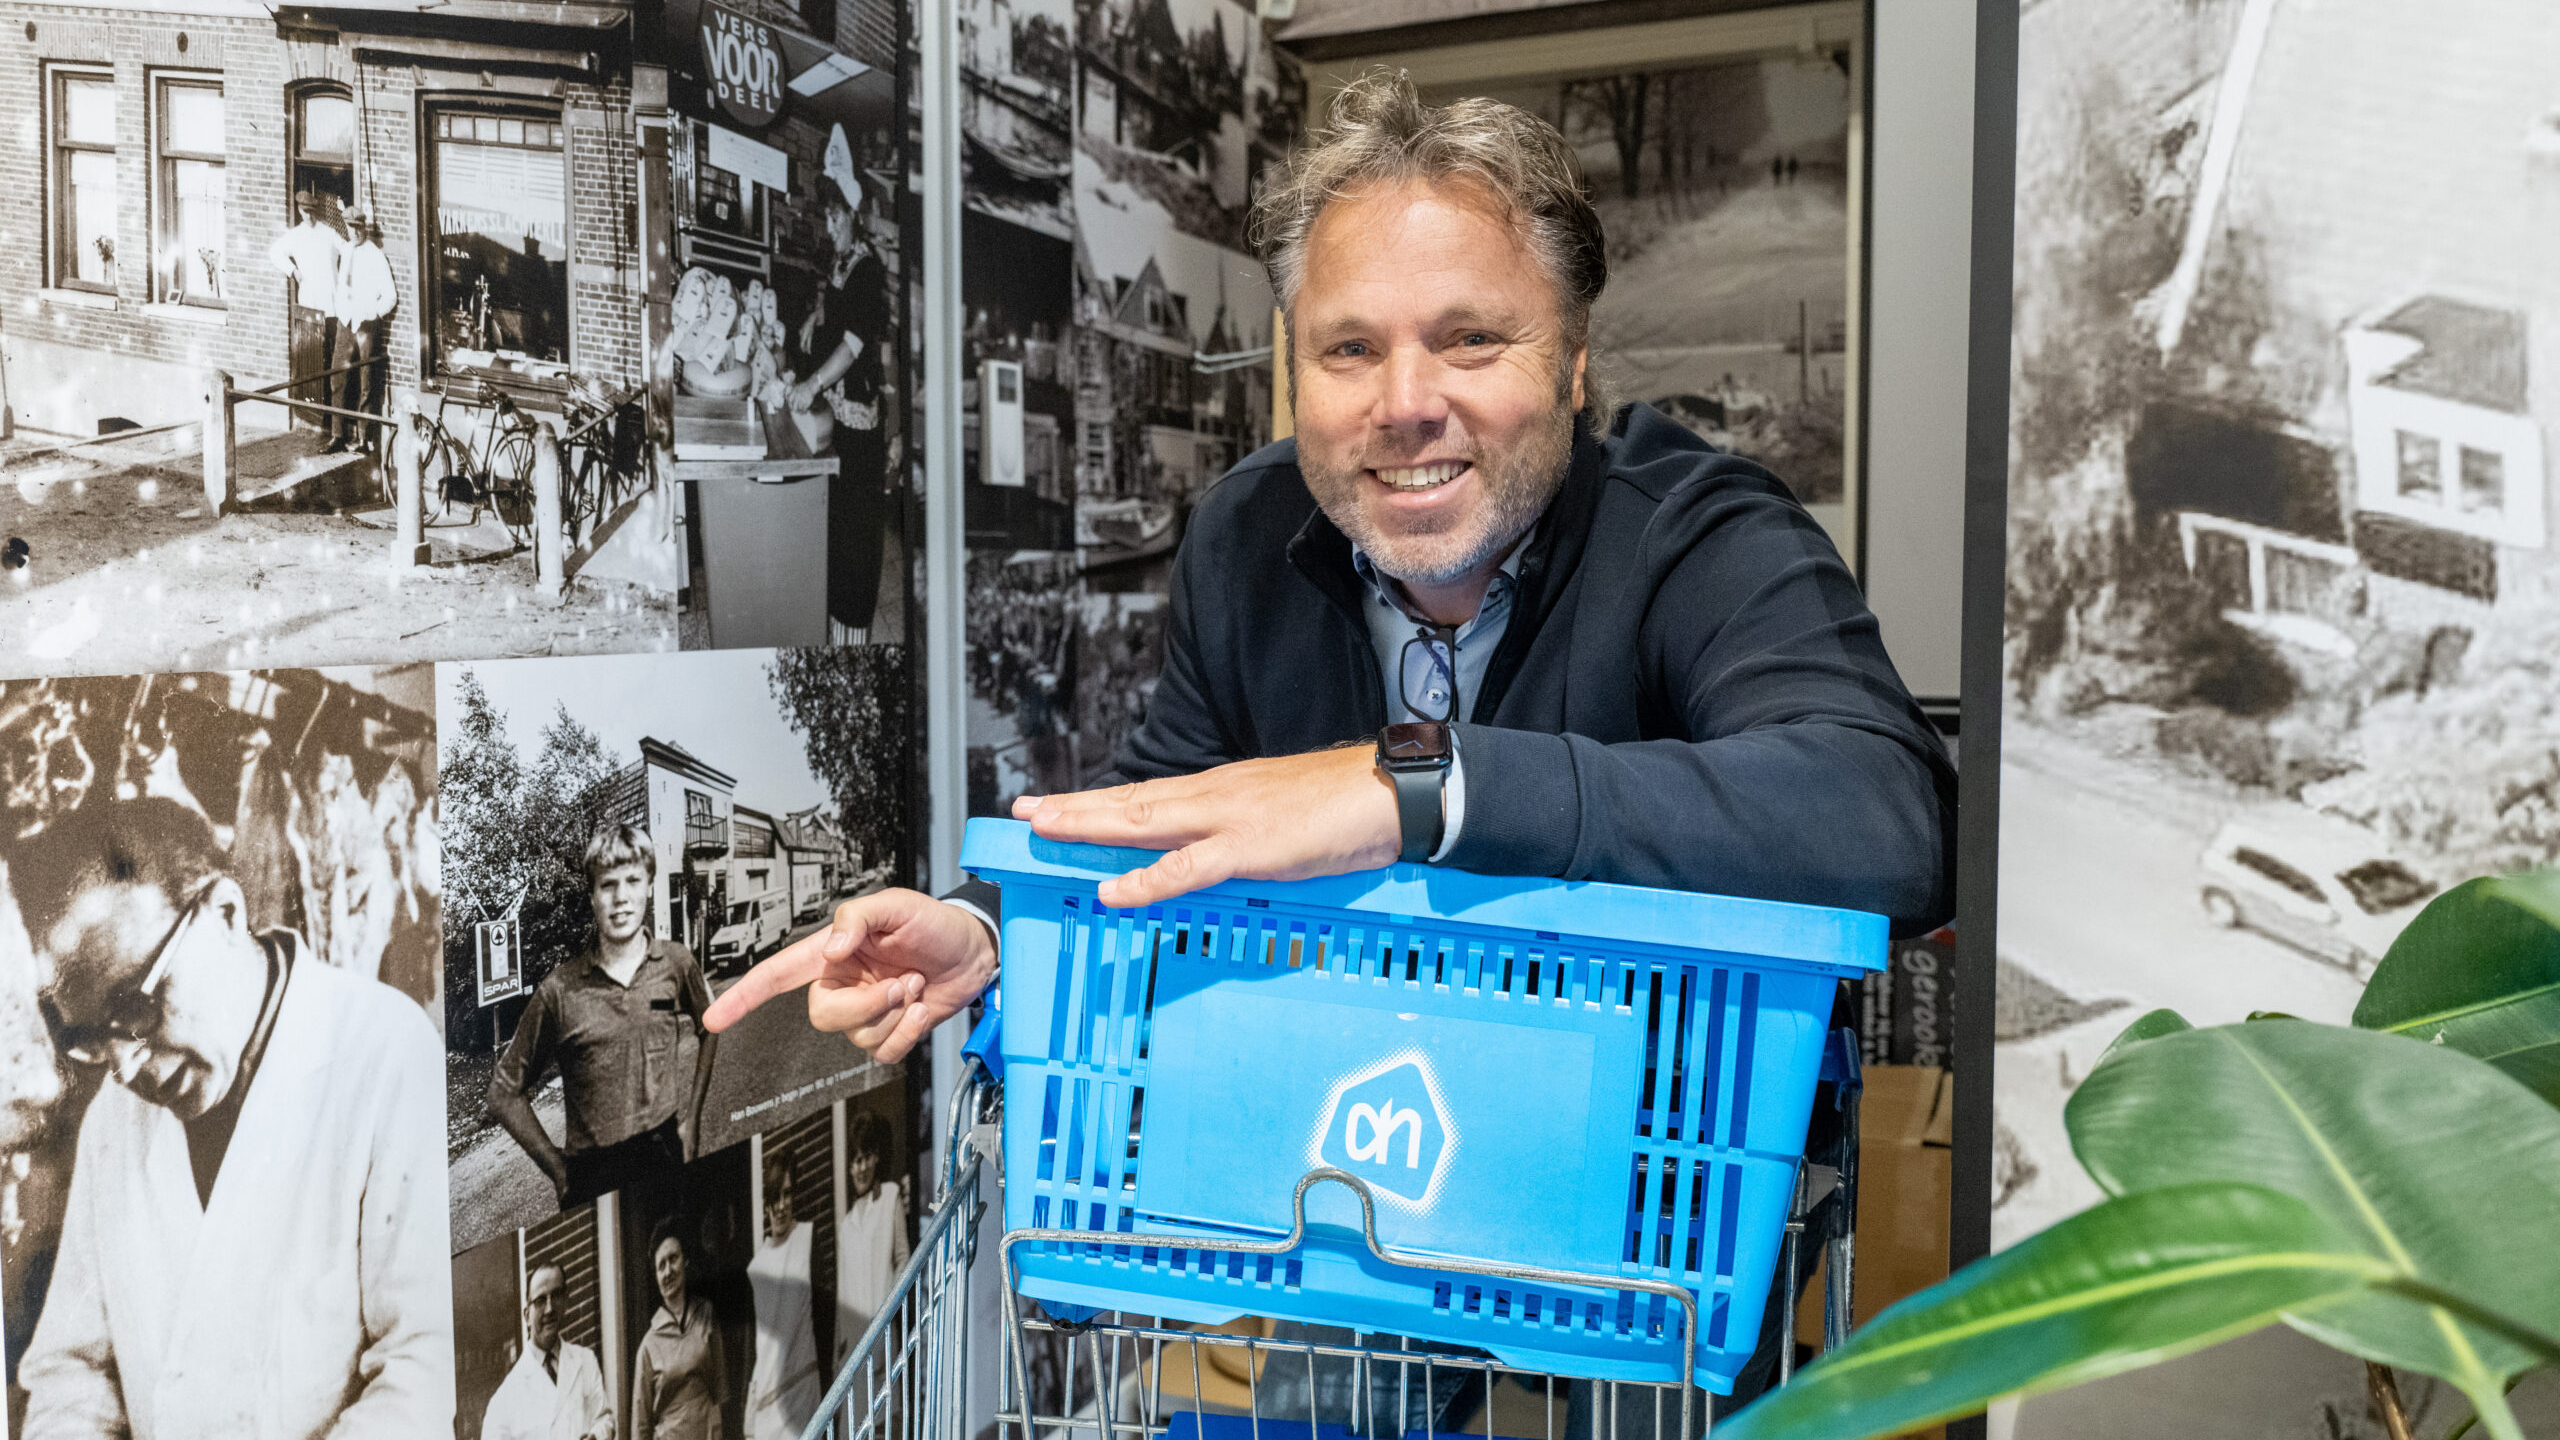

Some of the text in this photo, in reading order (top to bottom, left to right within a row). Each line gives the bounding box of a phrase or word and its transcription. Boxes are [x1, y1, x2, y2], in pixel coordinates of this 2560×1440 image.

[715, 10, 769, 46] VERS
[703, 25, 780, 98] VOOR
[718, 82, 775, 113] DEEL
[484, 979, 518, 998] SPAR
